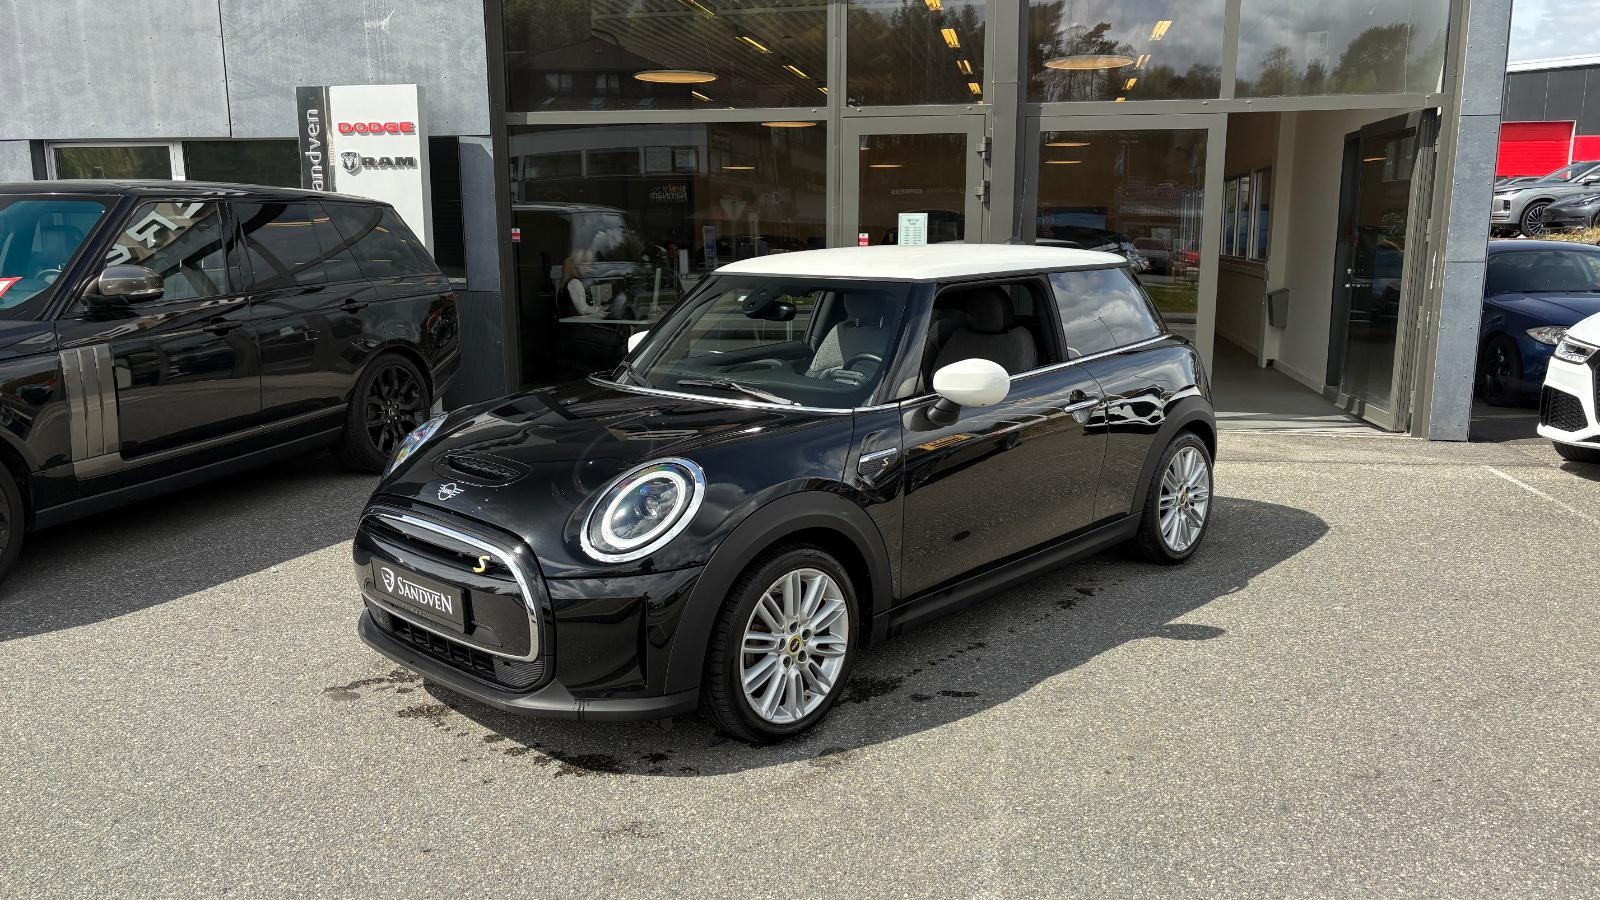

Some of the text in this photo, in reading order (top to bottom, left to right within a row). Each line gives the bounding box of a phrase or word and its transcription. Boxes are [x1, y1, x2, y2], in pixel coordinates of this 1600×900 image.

[338, 122, 415, 134] DODGE
[361, 156, 416, 168] RAM
[473, 555, 490, 573] S
